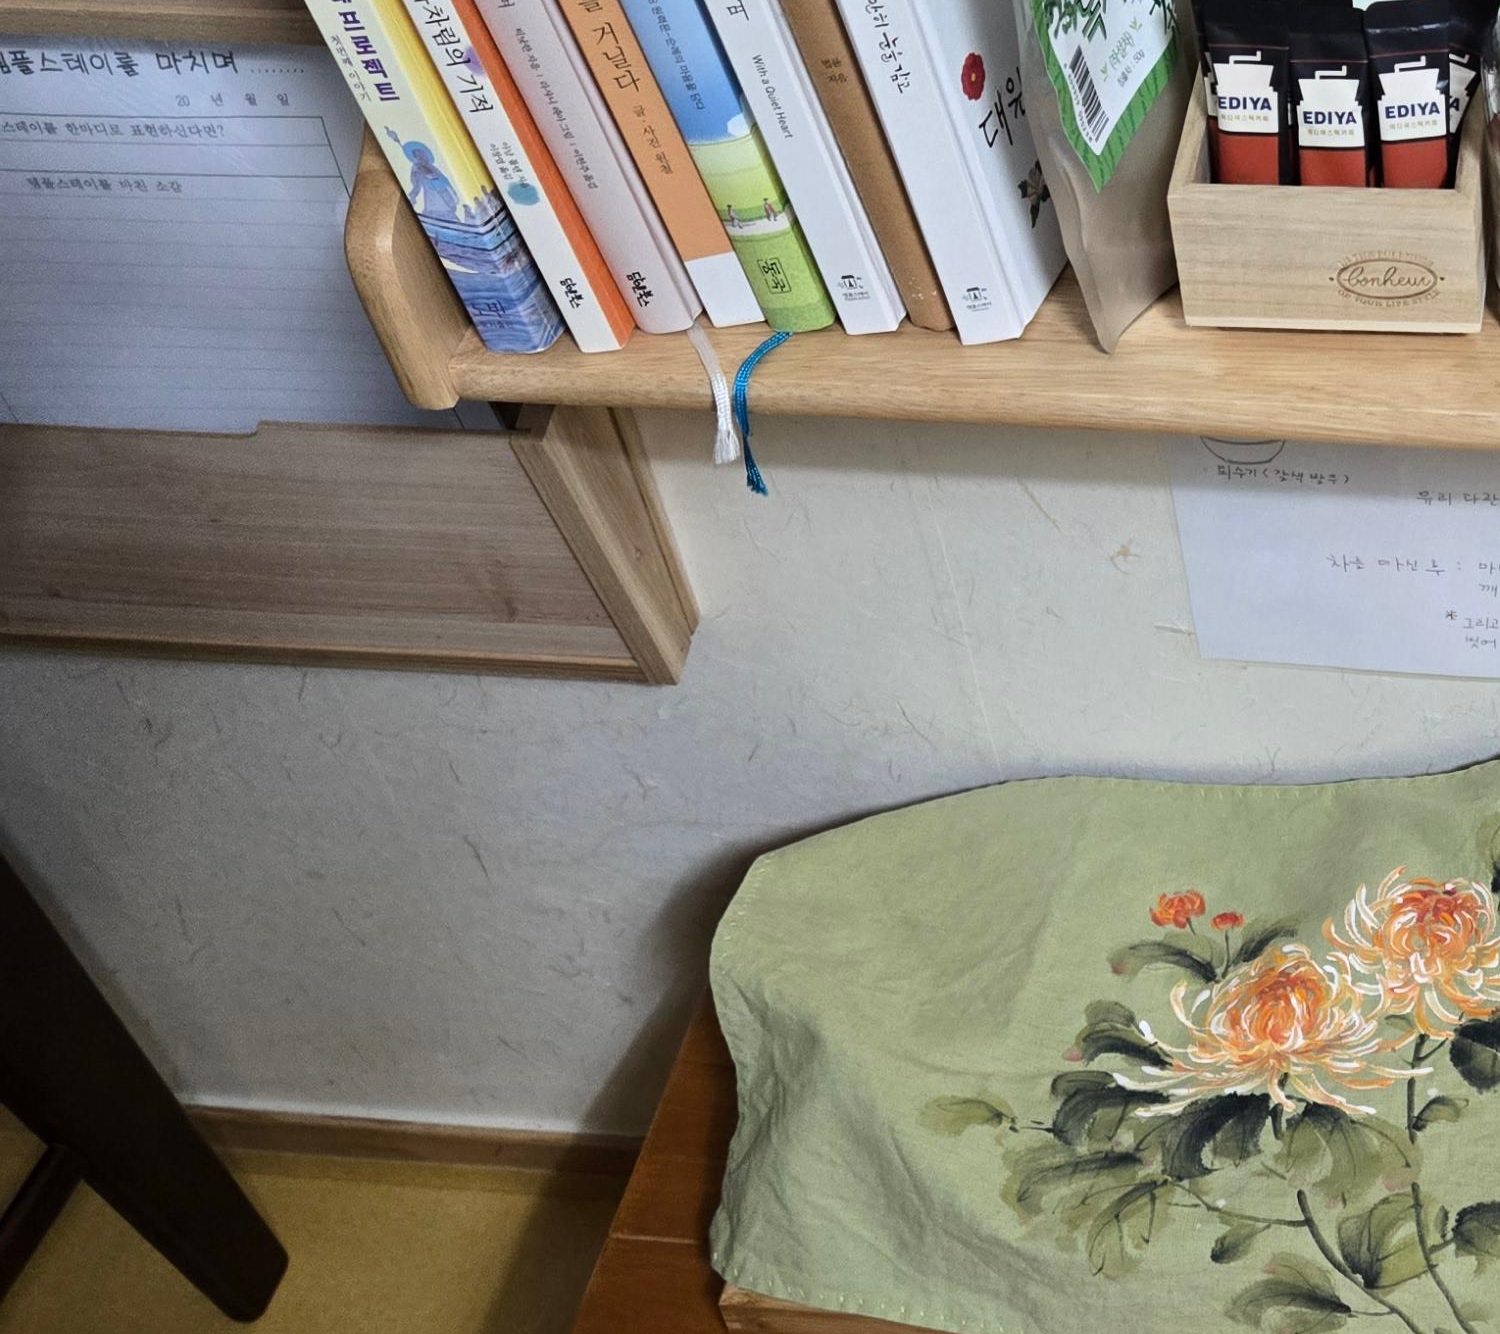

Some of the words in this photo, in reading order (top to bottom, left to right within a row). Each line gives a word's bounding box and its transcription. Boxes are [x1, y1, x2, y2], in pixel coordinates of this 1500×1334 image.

[155, 51, 238, 74] 마치며
[337, 10, 400, 101] 프로젝트
[592, 21, 640, 92] 거닐다
[176, 95, 190, 107] 20
[212, 93, 223, 107] 년
[245, 94, 257, 107] 월
[277, 93, 290, 107] 일
[459, 73, 494, 113] 기적
[751, 53, 768, 77] With
[764, 85, 782, 110] Quiet
[774, 111, 793, 138] Heart
[1217, 95, 1272, 112] EDIYA
[1384, 100, 1441, 119] EDIYA
[1302, 110, 1357, 126] EDIYA
[66, 123, 123, 137] 한마디로
[130, 124, 224, 138] 표현하신다면?
[1342, 266, 1431, 287] bonheur
[1463, 617, 1500, 630] 그리고
